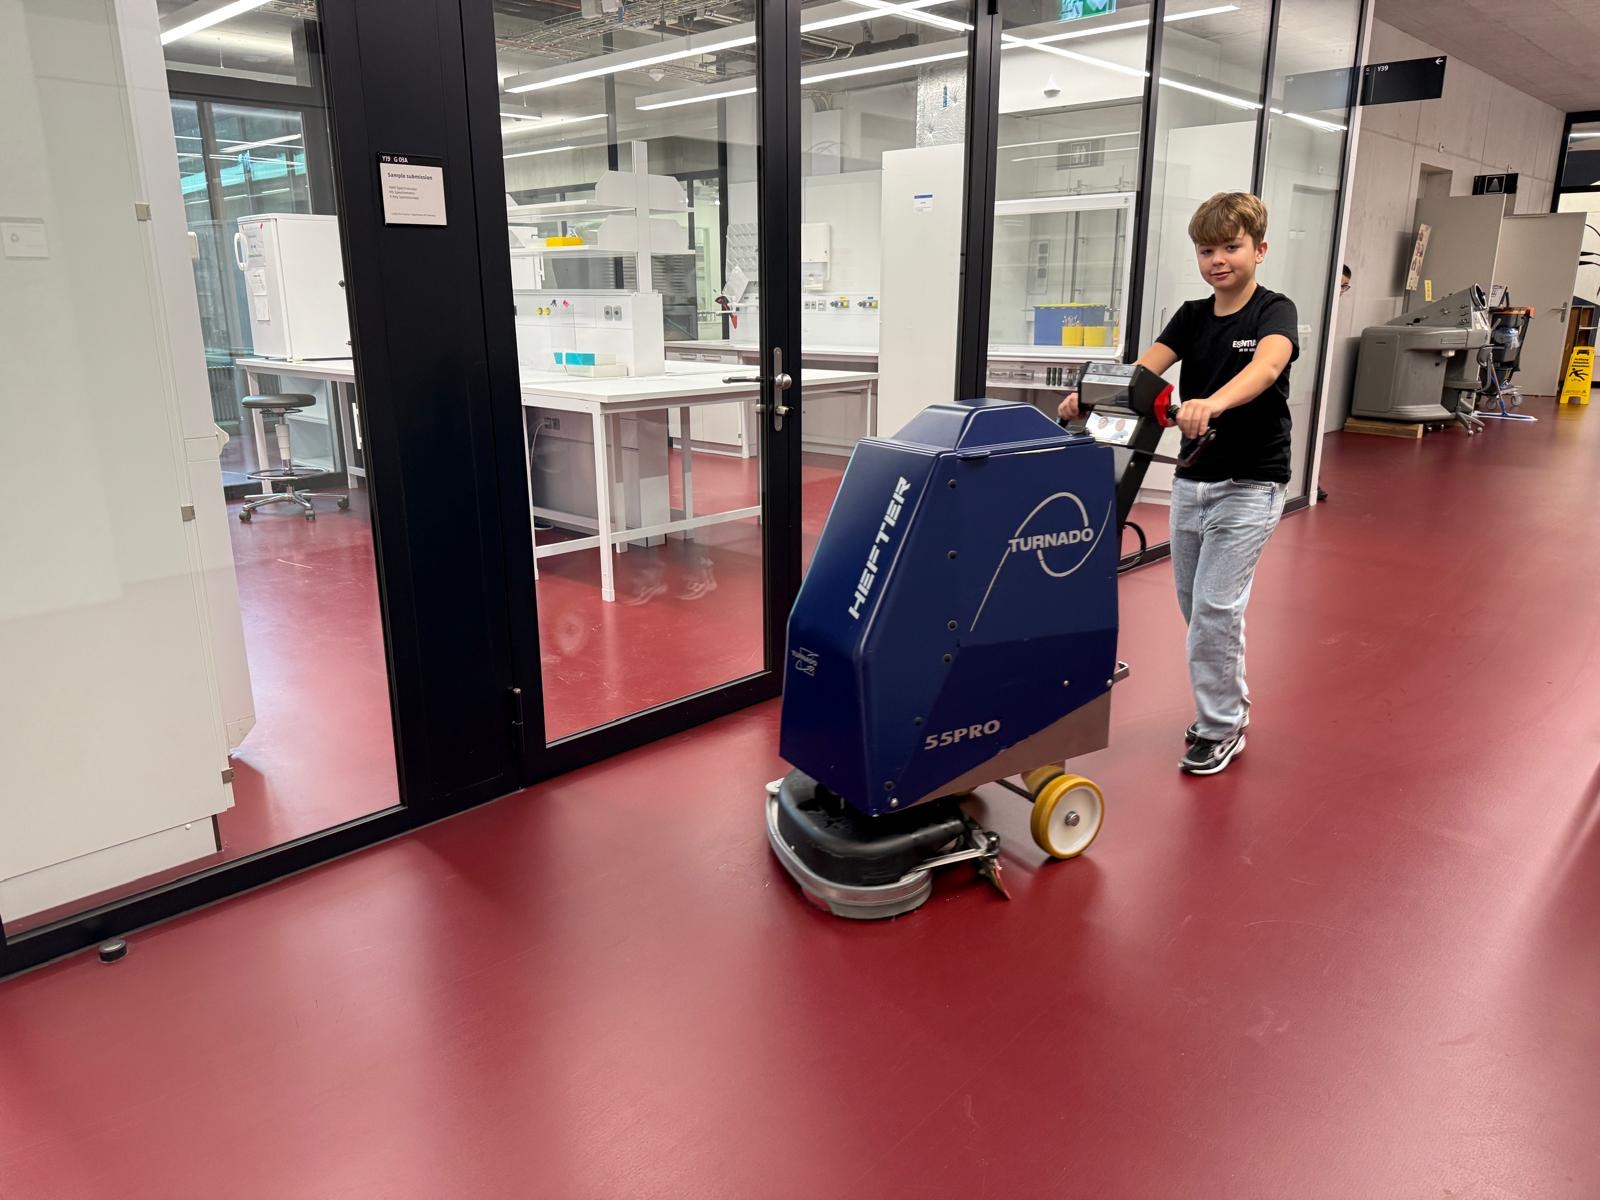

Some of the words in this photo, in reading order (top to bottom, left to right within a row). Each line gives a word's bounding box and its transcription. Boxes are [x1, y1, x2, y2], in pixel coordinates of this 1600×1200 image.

[848, 476, 911, 620] HEFTER
[1008, 528, 1094, 553] TURNADO
[924, 719, 1001, 750] 55PRO
